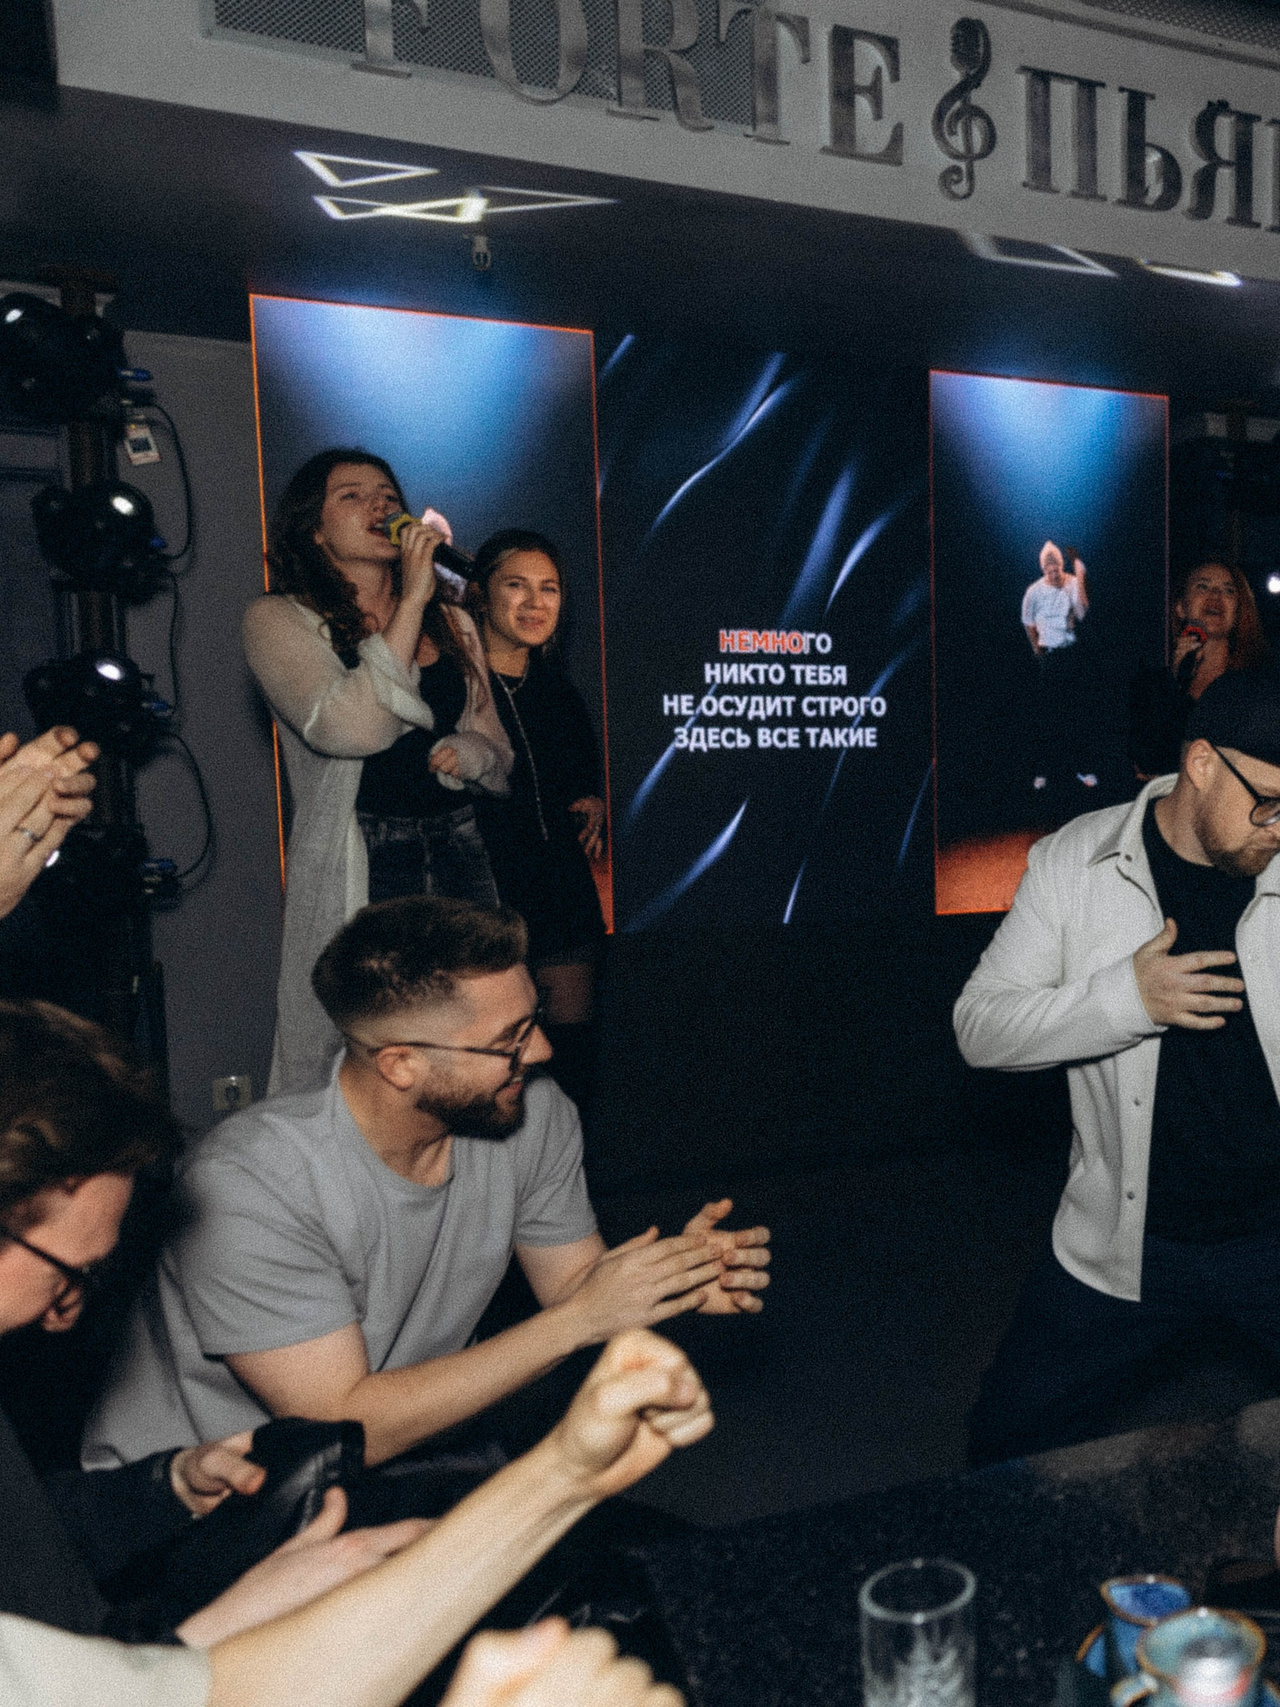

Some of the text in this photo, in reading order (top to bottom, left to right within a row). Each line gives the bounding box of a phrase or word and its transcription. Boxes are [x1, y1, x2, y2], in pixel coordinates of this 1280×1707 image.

[719, 629, 833, 654] НЕМНОГО
[704, 662, 848, 686] НИКТО ТЕБЯ
[662, 694, 887, 721] НЕ ОСУДИТ СТРОГО
[674, 727, 878, 752] ЗДЕСЬ ВСЕ ТАКИЕ
